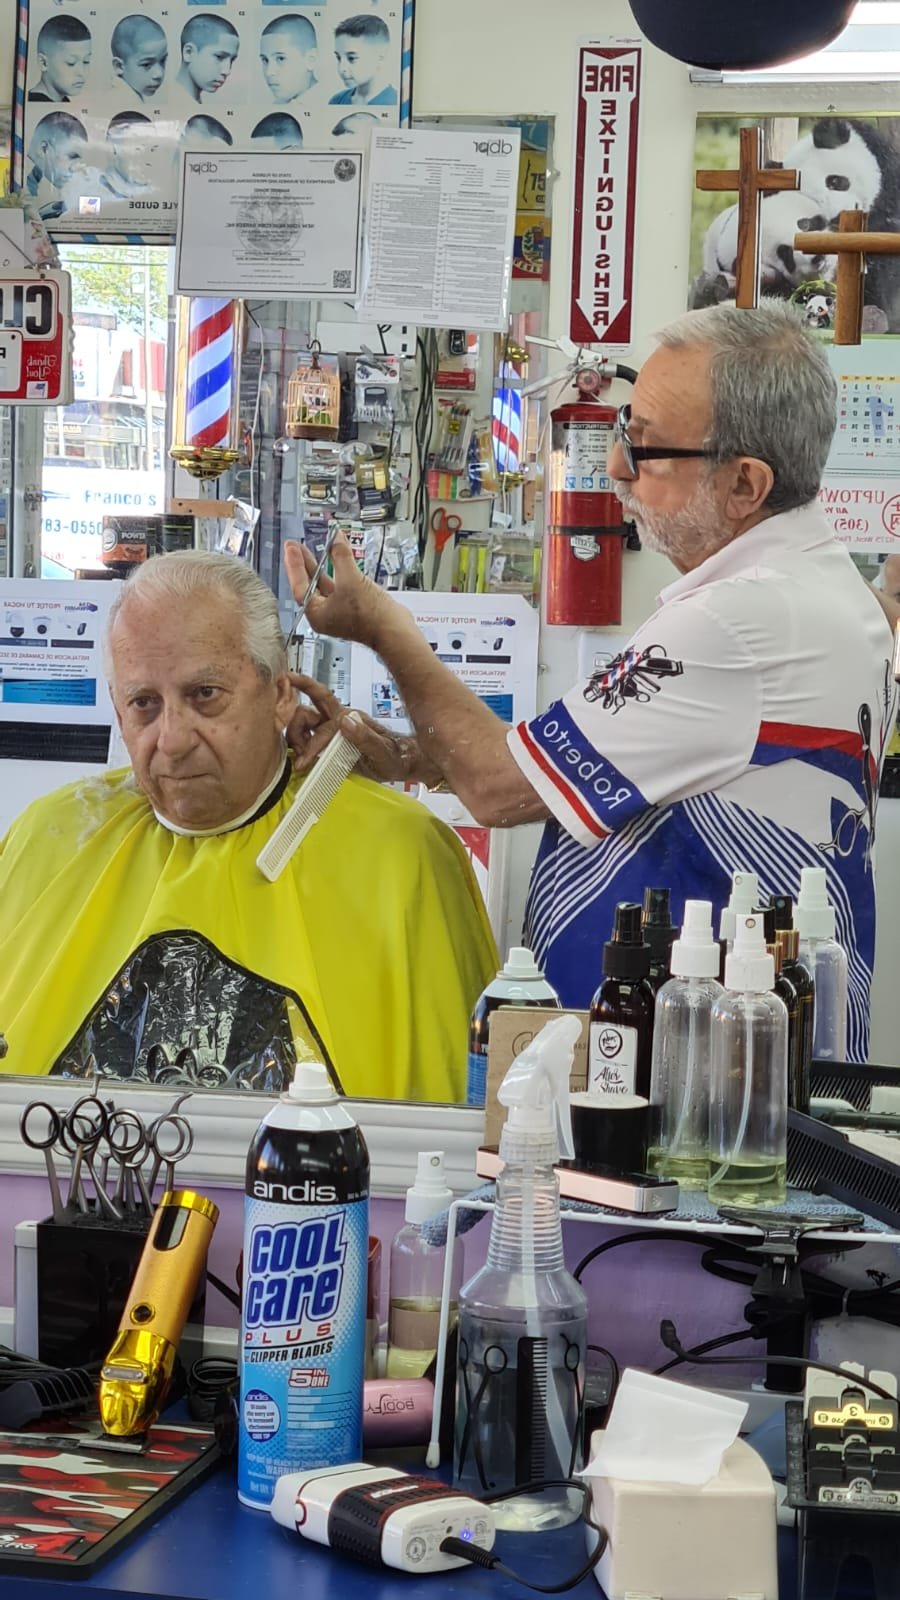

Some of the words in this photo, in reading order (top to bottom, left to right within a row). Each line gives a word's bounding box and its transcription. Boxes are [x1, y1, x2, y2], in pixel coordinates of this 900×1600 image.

[253, 1180, 337, 1202] andis
[250, 1218, 342, 1274] COOL
[246, 1268, 339, 1324] care
[245, 1322, 332, 1344] PLUS
[250, 1349, 289, 1363] CLIPPER
[291, 1341, 334, 1360] BLADES
[290, 1368, 312, 1388] 5
[366, 1394, 415, 1416] BODIFY
[849, 1406, 858, 1416] 3
